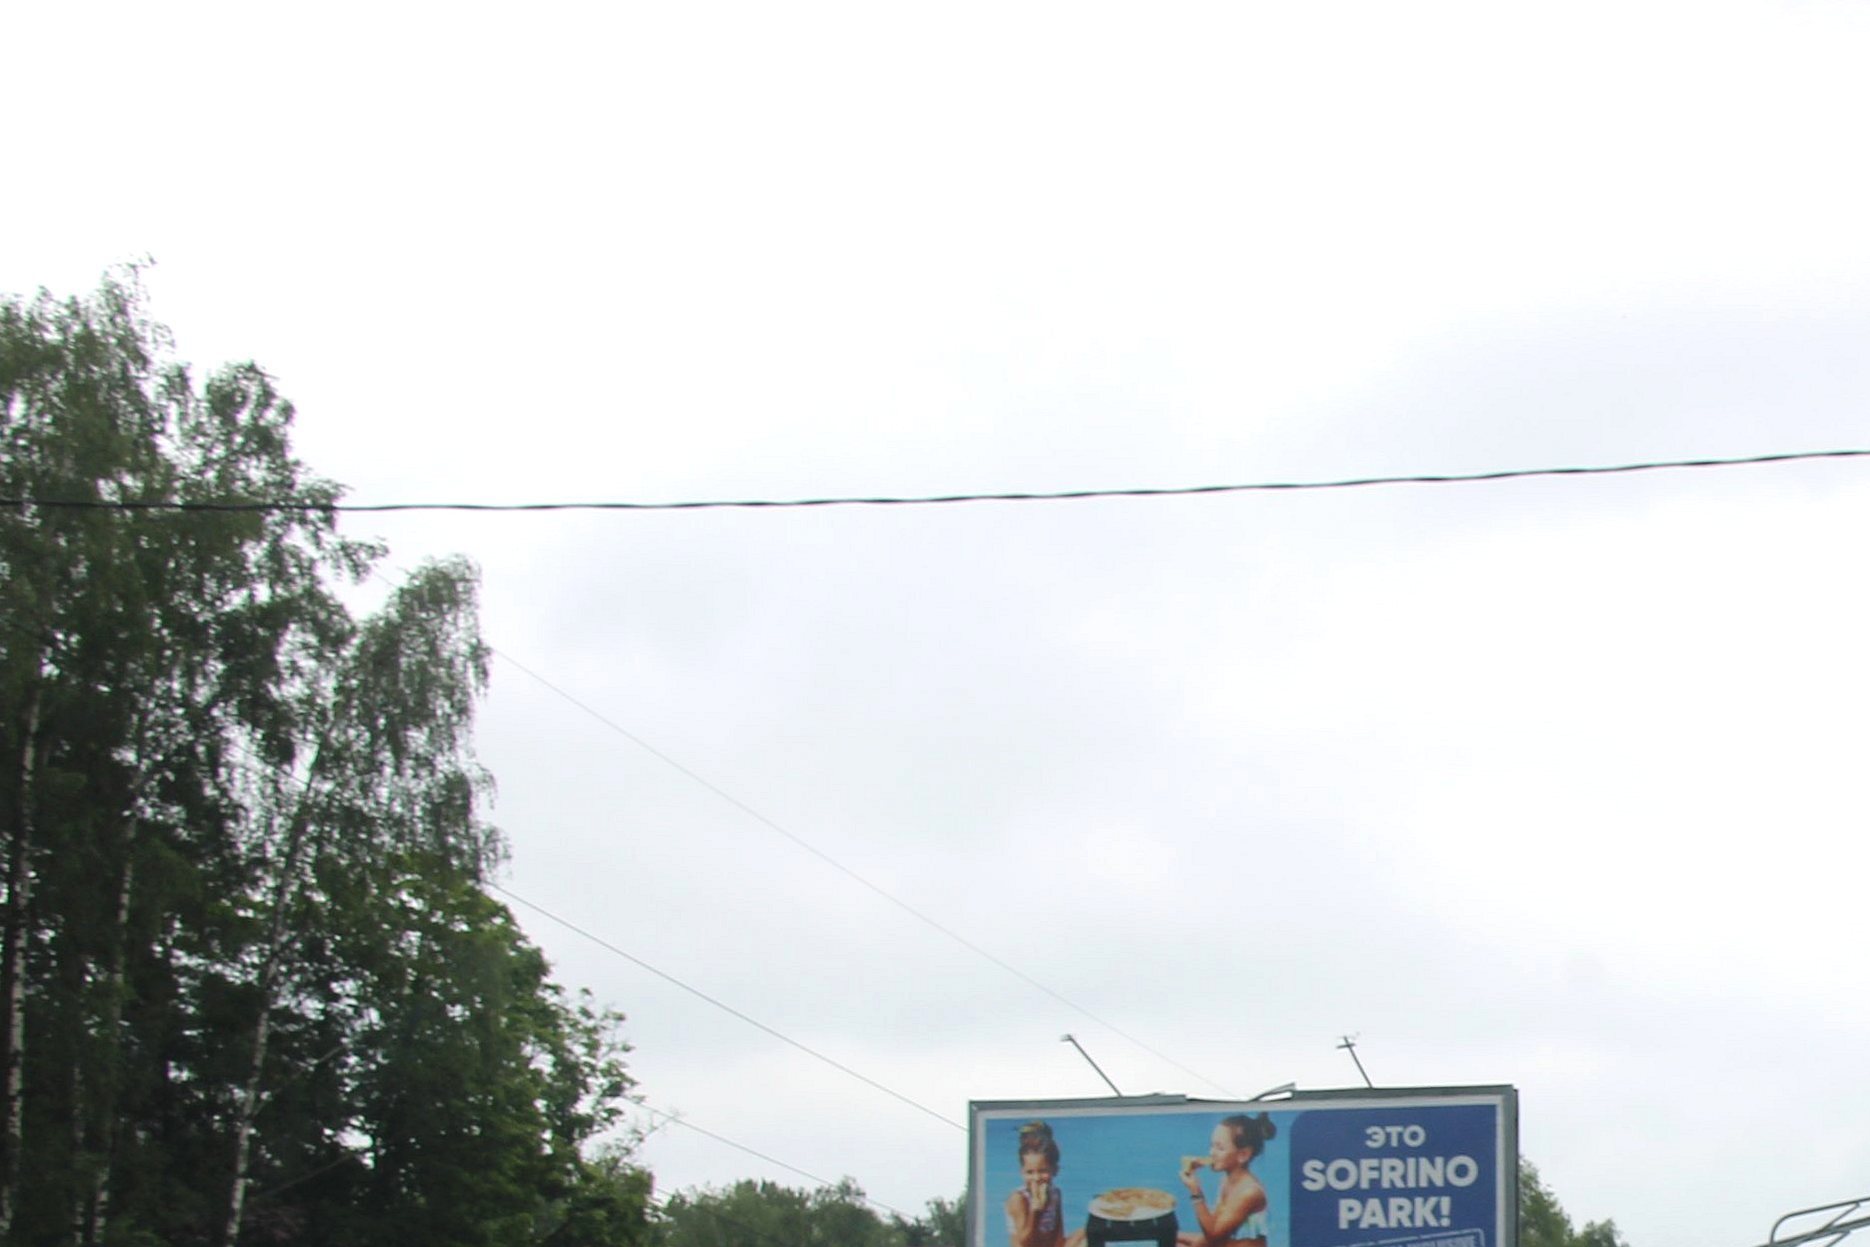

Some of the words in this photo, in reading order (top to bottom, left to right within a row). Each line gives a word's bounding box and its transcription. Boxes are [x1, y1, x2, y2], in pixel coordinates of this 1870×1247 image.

[1365, 1124, 1426, 1148] ЭТО
[1302, 1155, 1478, 1191] SOFRINO
[1338, 1195, 1451, 1229] PARK!
